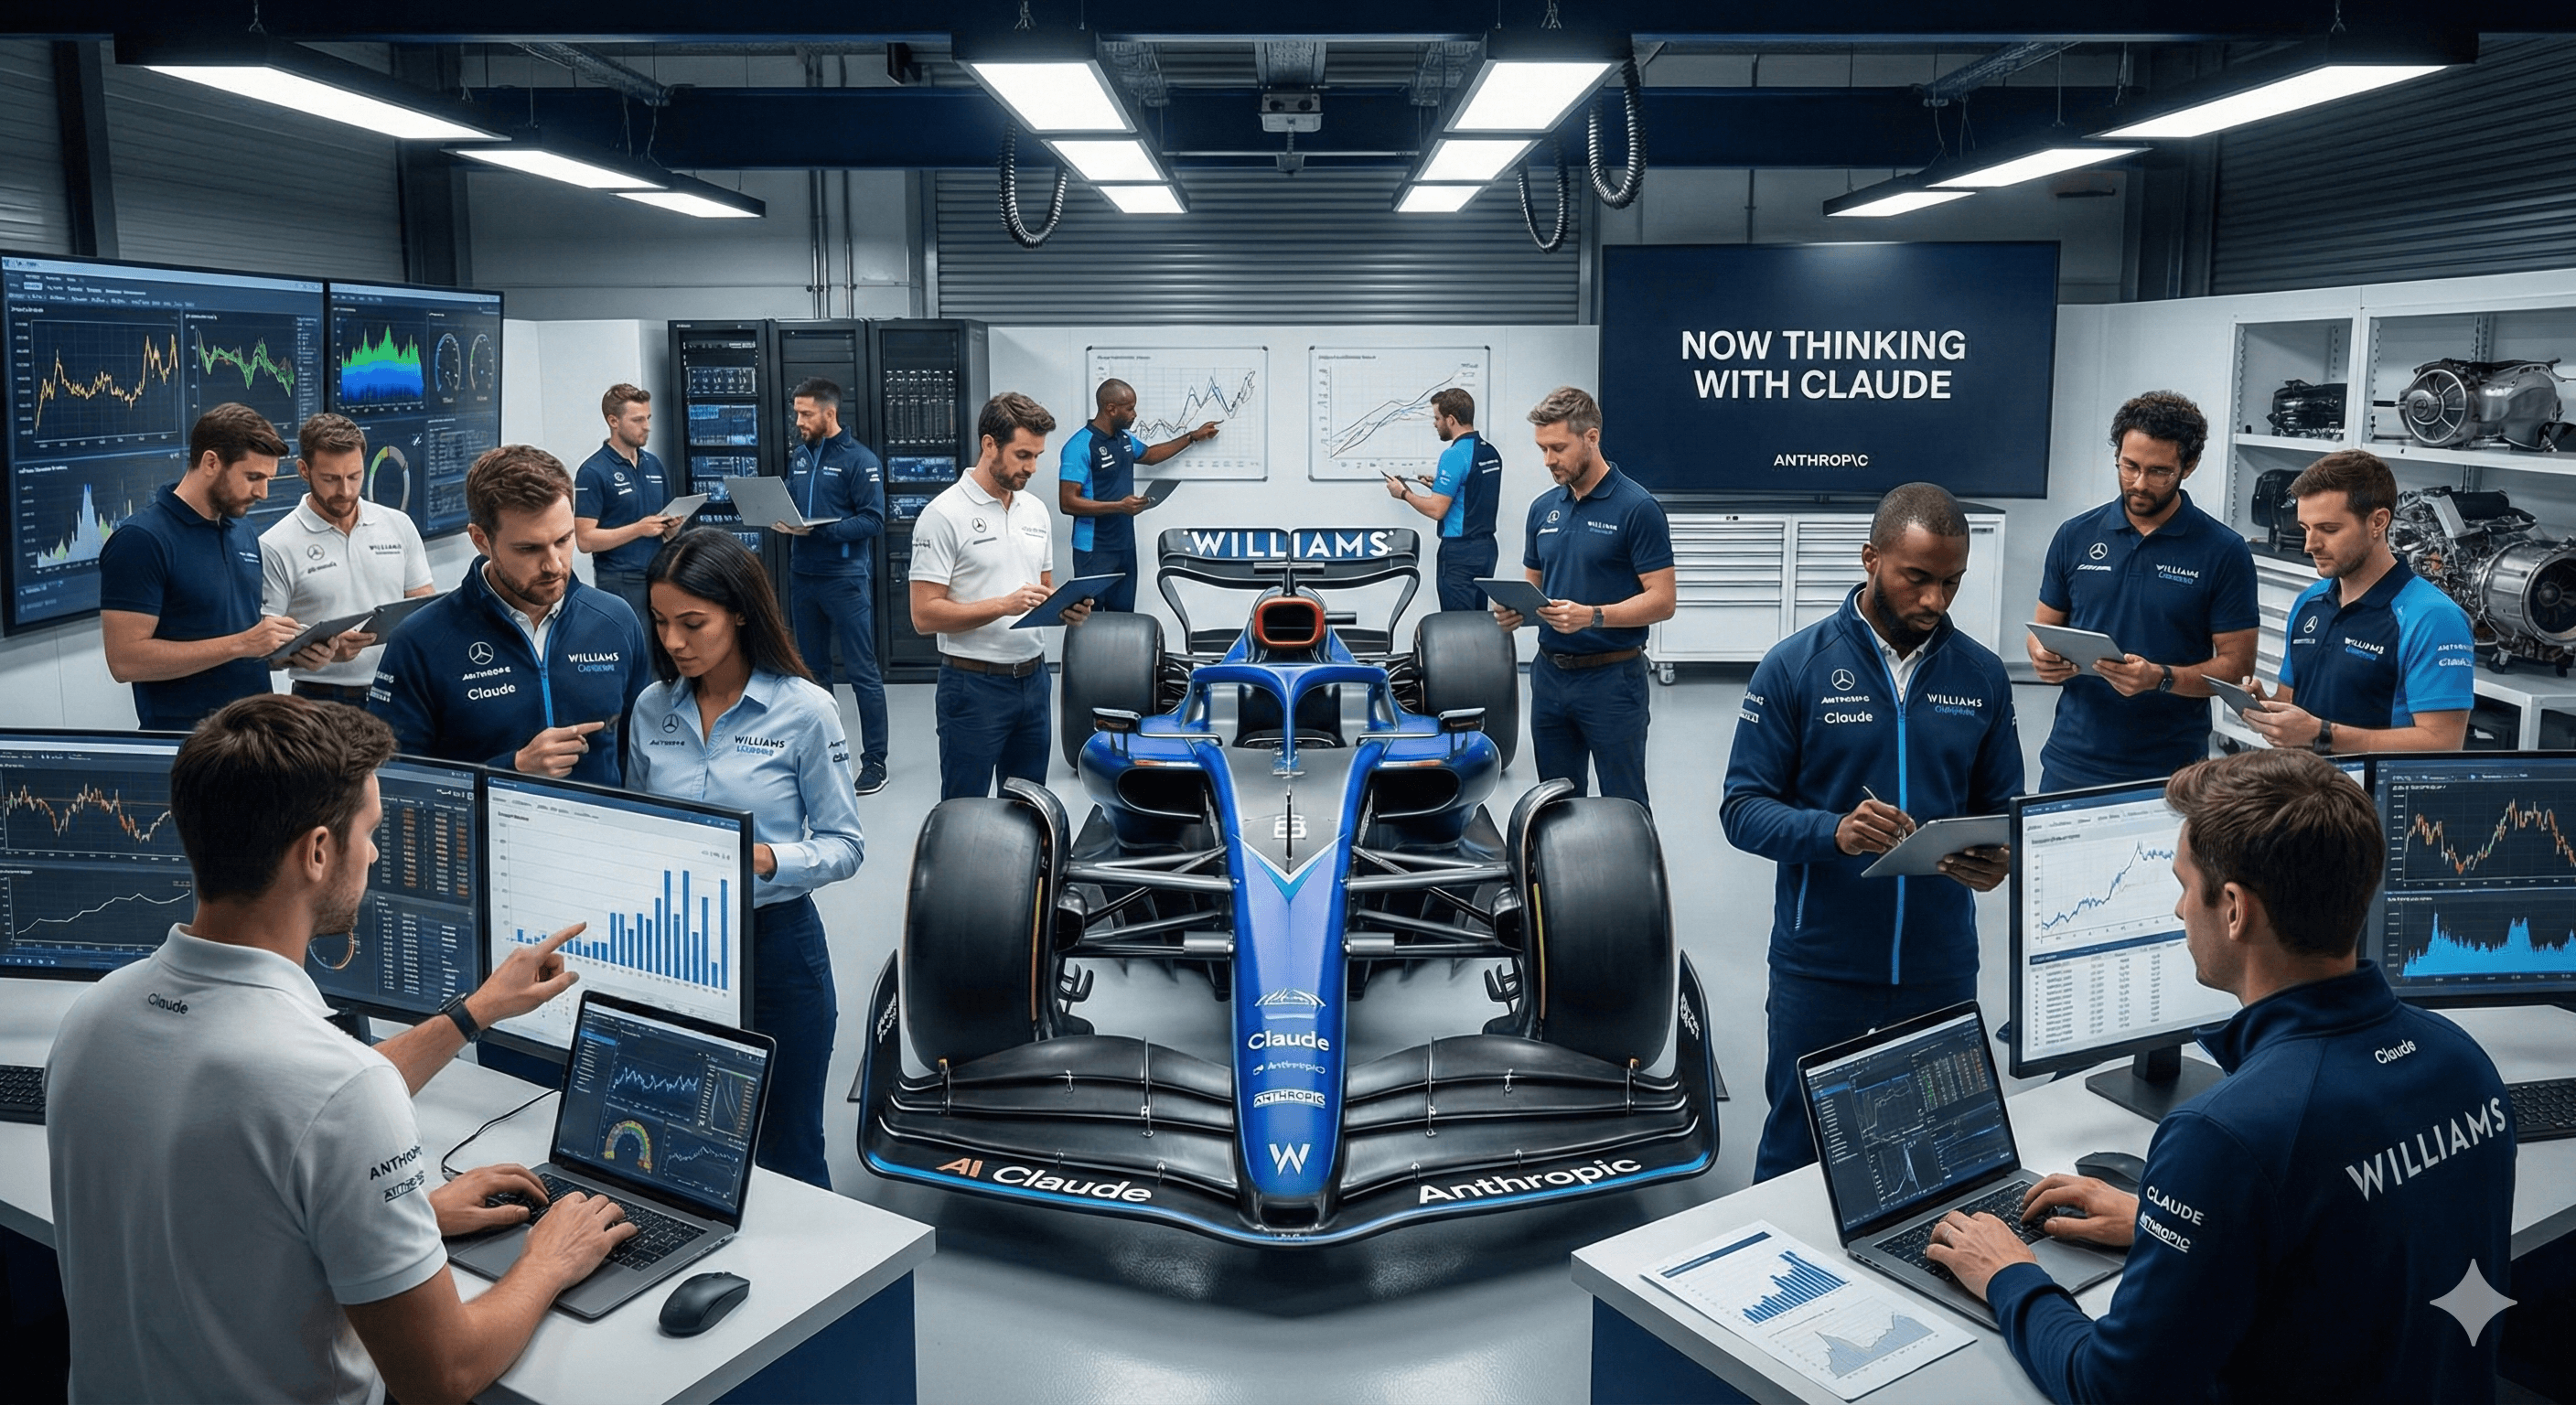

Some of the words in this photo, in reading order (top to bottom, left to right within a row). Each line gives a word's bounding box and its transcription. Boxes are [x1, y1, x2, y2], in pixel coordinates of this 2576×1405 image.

[1681, 330, 1773, 360] NOW
[1782, 329, 1966, 360] THINKING
[1694, 370, 1790, 399] WITH
[1800, 370, 1952, 400] CLAUDE
[1190, 531, 1389, 558] WILLIAMS
[567, 651, 619, 663] WILLIAMS
[467, 682, 516, 700] Claude
[1927, 692, 1983, 708] WILLIAMS
[1824, 710, 1873, 724] Claude
[148, 992, 188, 1014] Claude
[1248, 1030, 1330, 1051] Claude
[2375, 1039, 2417, 1064] Claude
[2345, 1097, 2506, 1202] WILLIAMS
[992, 1165, 1153, 1203] Claude
[1418, 1158, 1643, 1205] Anthropic
[2146, 1185, 2206, 1227] CLAUDE
